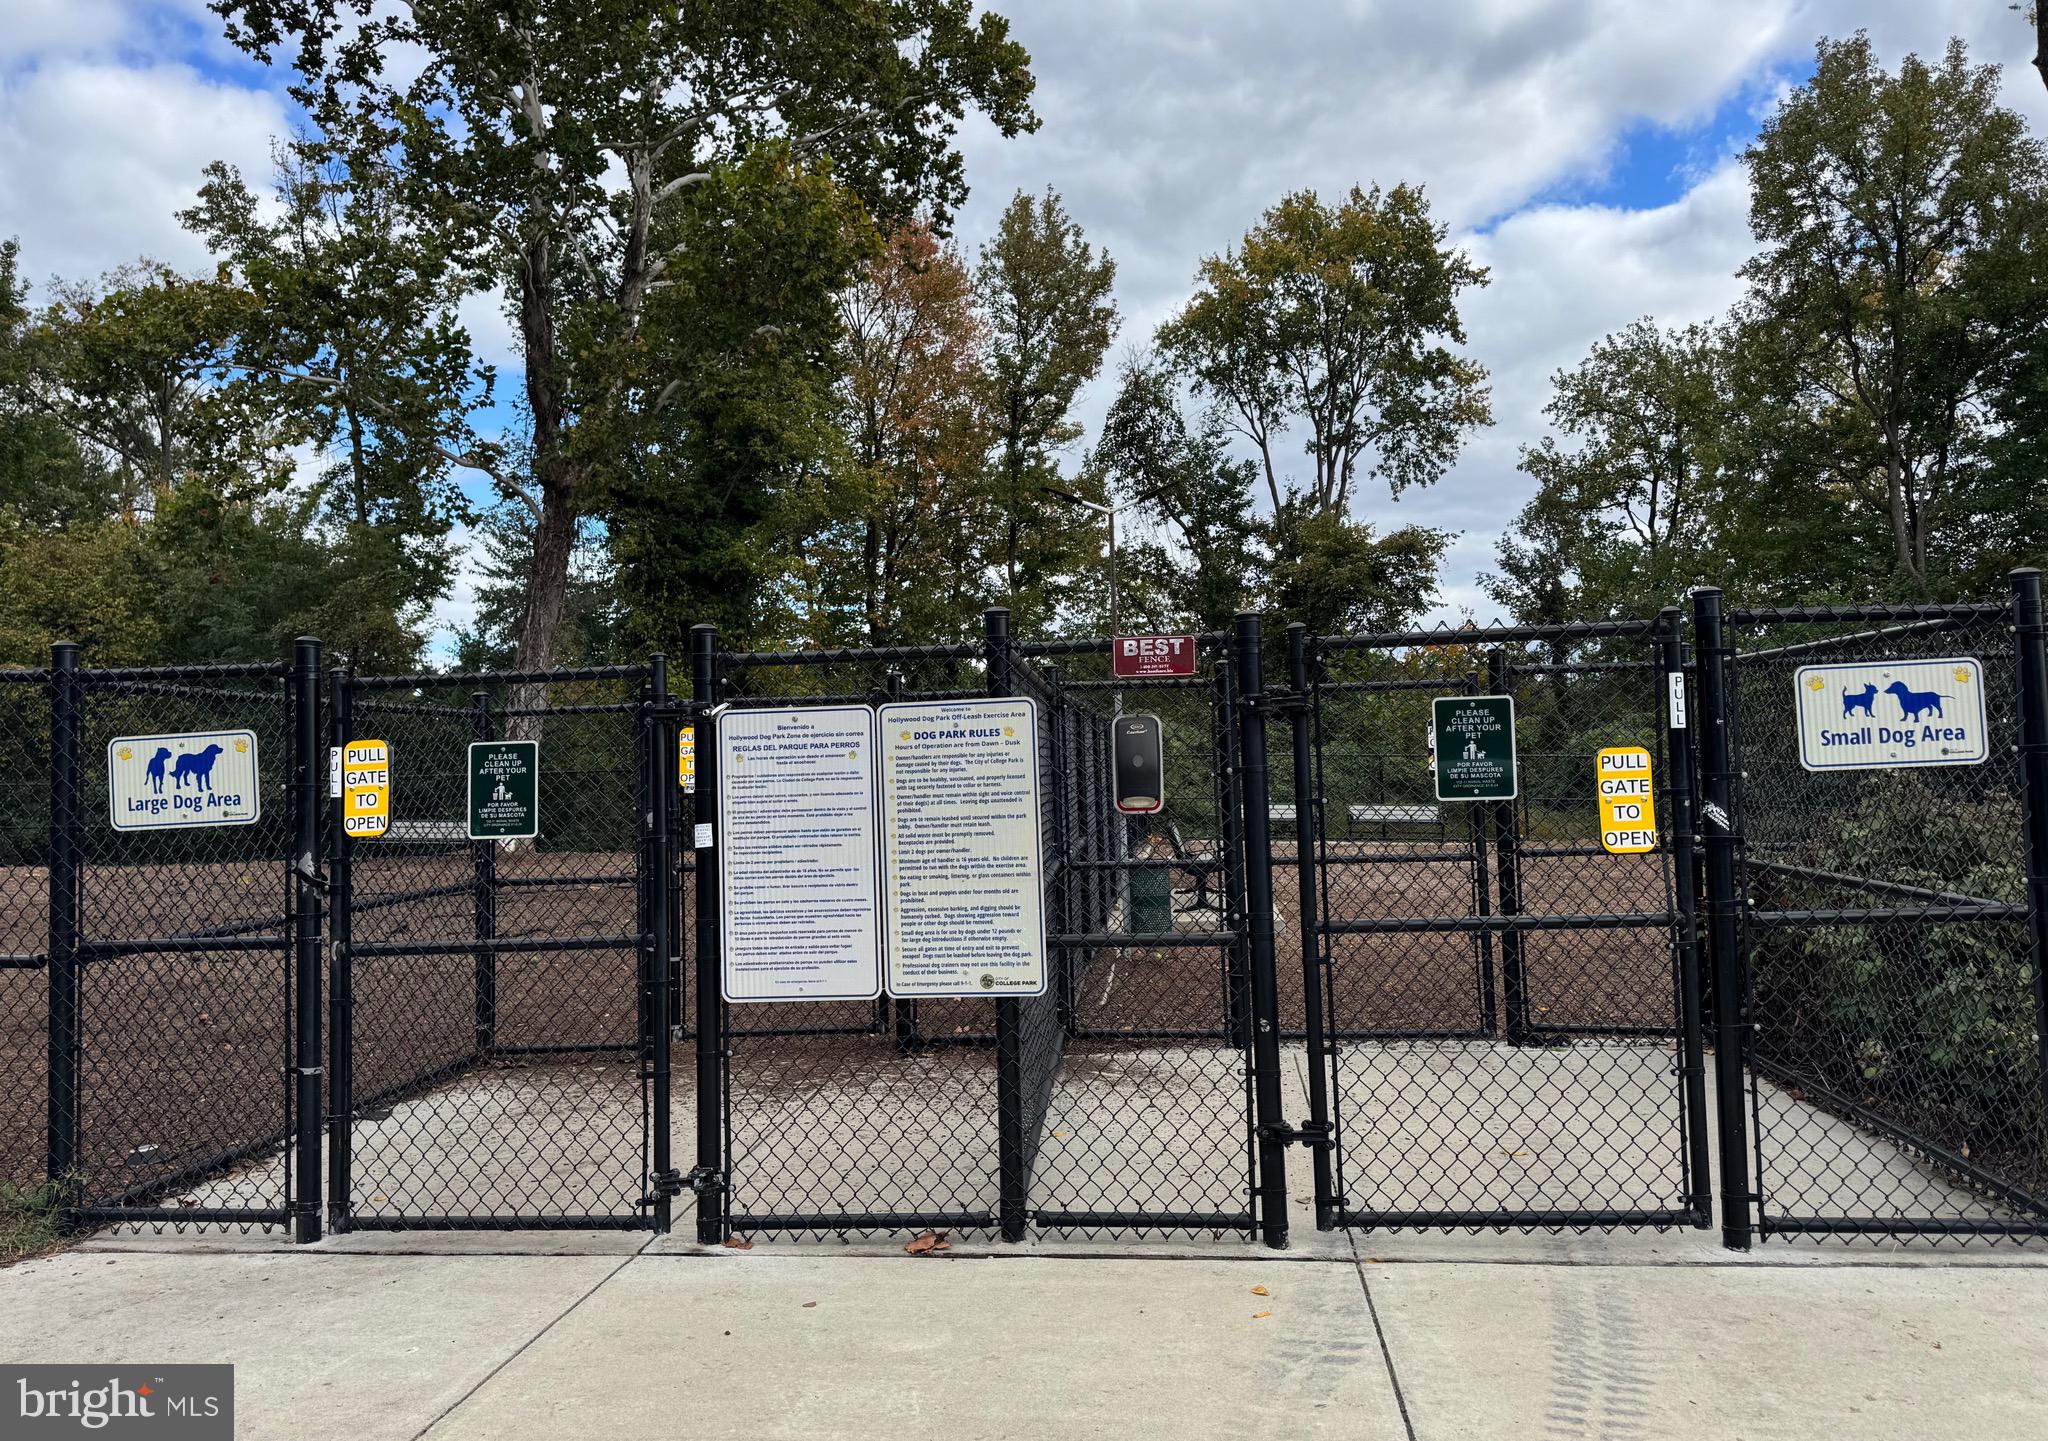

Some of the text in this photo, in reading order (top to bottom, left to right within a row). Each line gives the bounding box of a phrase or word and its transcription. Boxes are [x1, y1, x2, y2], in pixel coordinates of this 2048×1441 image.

[1124, 638, 1184, 656] BEST
[1674, 676, 1684, 724] PULL
[888, 716, 921, 725] Hollywood
[922, 715, 934, 723] Dog
[914, 728, 1000, 740] DOG PARK RULES
[1821, 726, 1965, 747] Small Dog Area
[922, 742, 953, 751] Operation
[348, 749, 385, 762] PULL
[1602, 754, 1646, 769] PULL
[346, 771, 386, 784] GATE
[1601, 779, 1649, 794] GATE
[128, 793, 240, 814] Large Dog Area
[356, 794, 377, 806] TO
[1614, 805, 1640, 819] TO
[346, 816, 385, 830] OPEN
[1605, 831, 1654, 846] OPEN
[936, 847, 972, 855] owner/handler.
